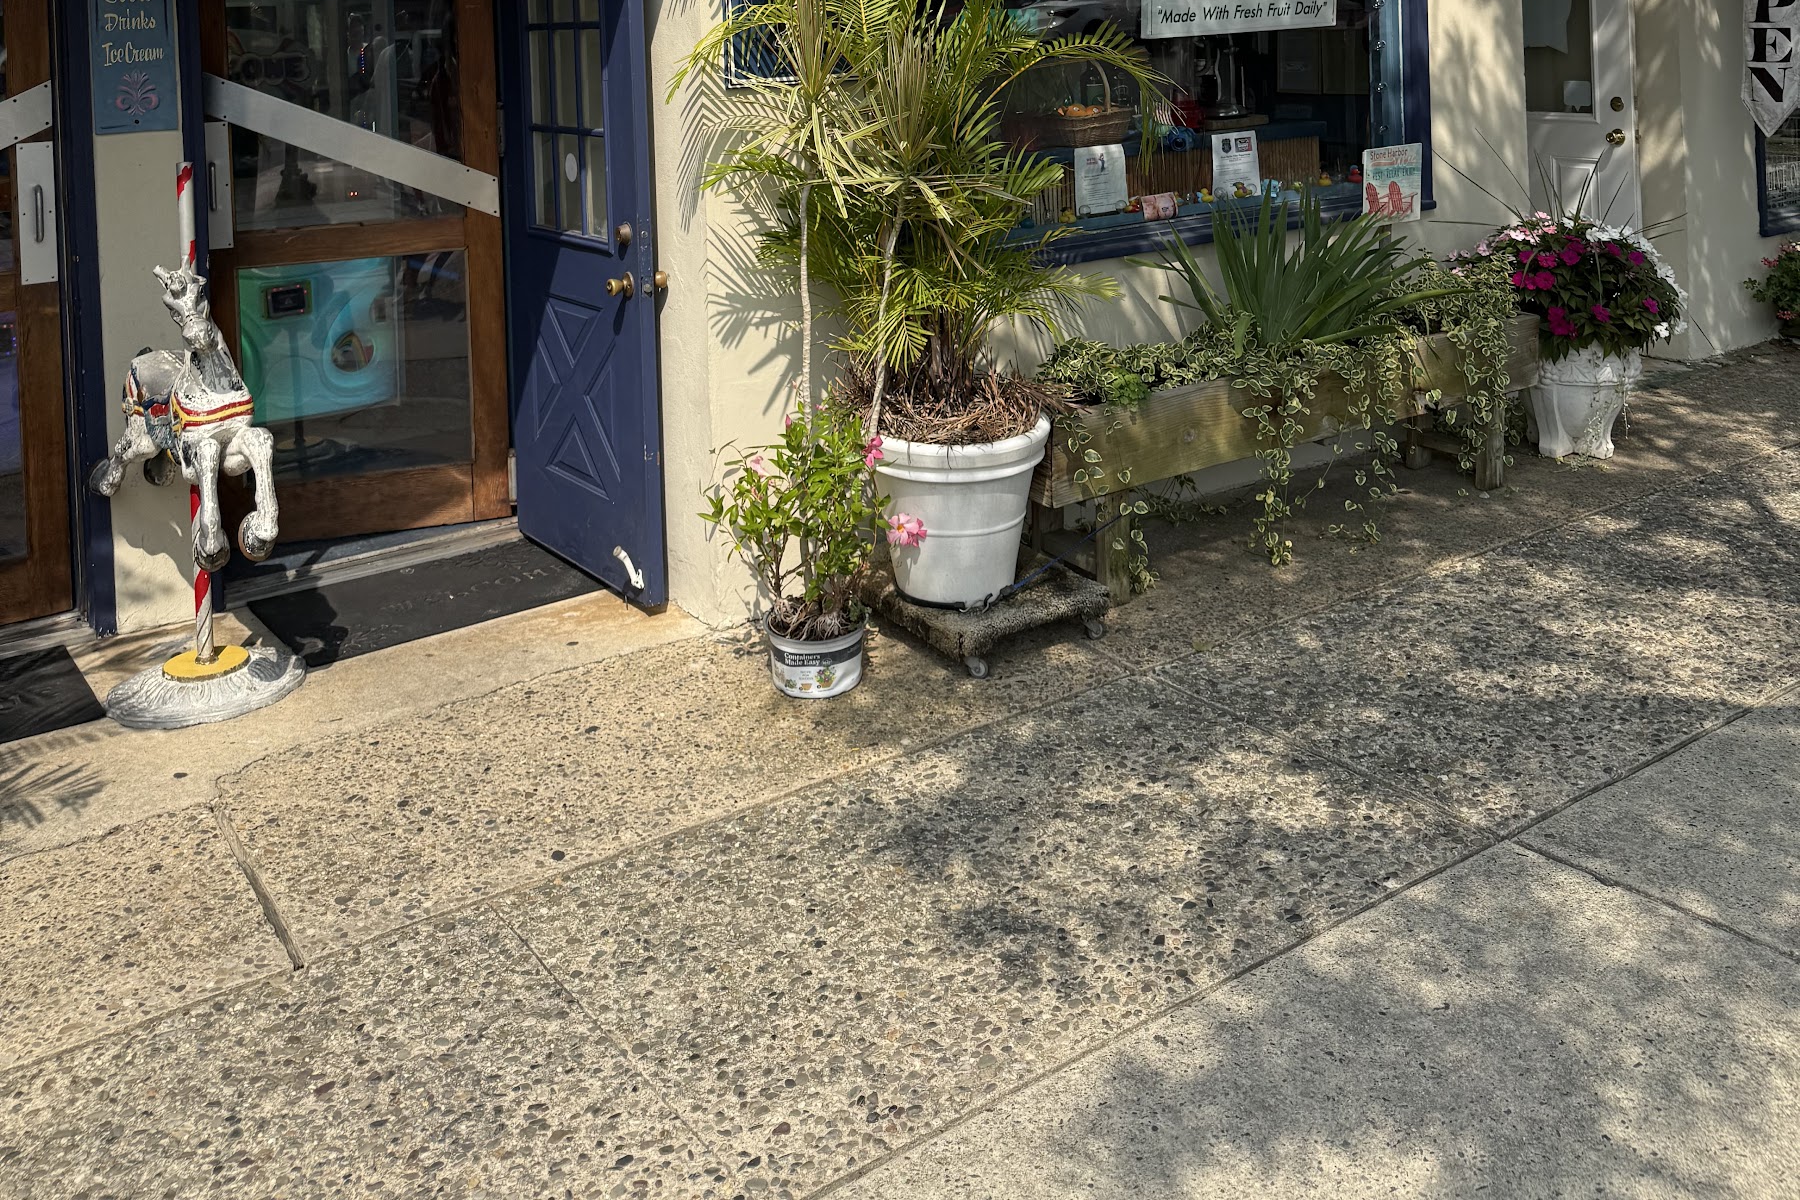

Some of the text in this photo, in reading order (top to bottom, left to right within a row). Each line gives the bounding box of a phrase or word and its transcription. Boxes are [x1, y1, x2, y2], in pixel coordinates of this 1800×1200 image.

[1203, 5, 1229, 20] With
[1233, 3, 1263, 19] Fresh
[1267, 2, 1291, 18] Fruit
[104, 9, 156, 32] Drinks
[1387, 148, 1408, 159] Harbor
